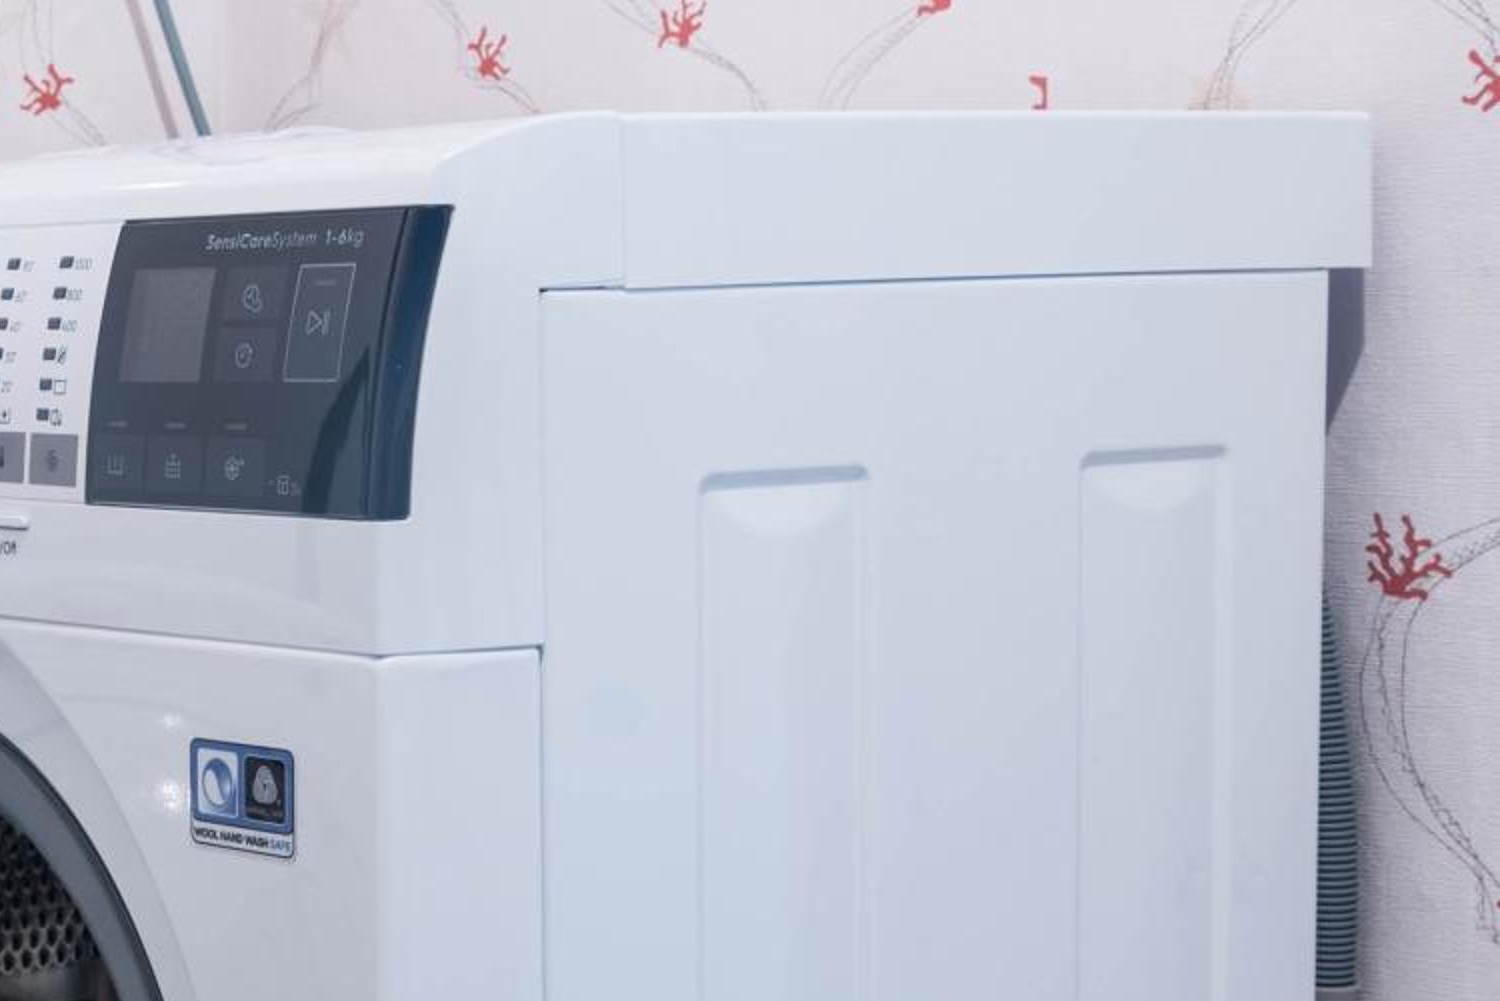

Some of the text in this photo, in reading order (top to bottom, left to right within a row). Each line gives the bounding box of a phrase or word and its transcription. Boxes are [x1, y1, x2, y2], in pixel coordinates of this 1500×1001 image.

[325, 228, 365, 248] 1-6kg
[195, 828, 218, 841] WOOL
[220, 832, 243, 844] HAND
[245, 836, 269, 849] WASH
